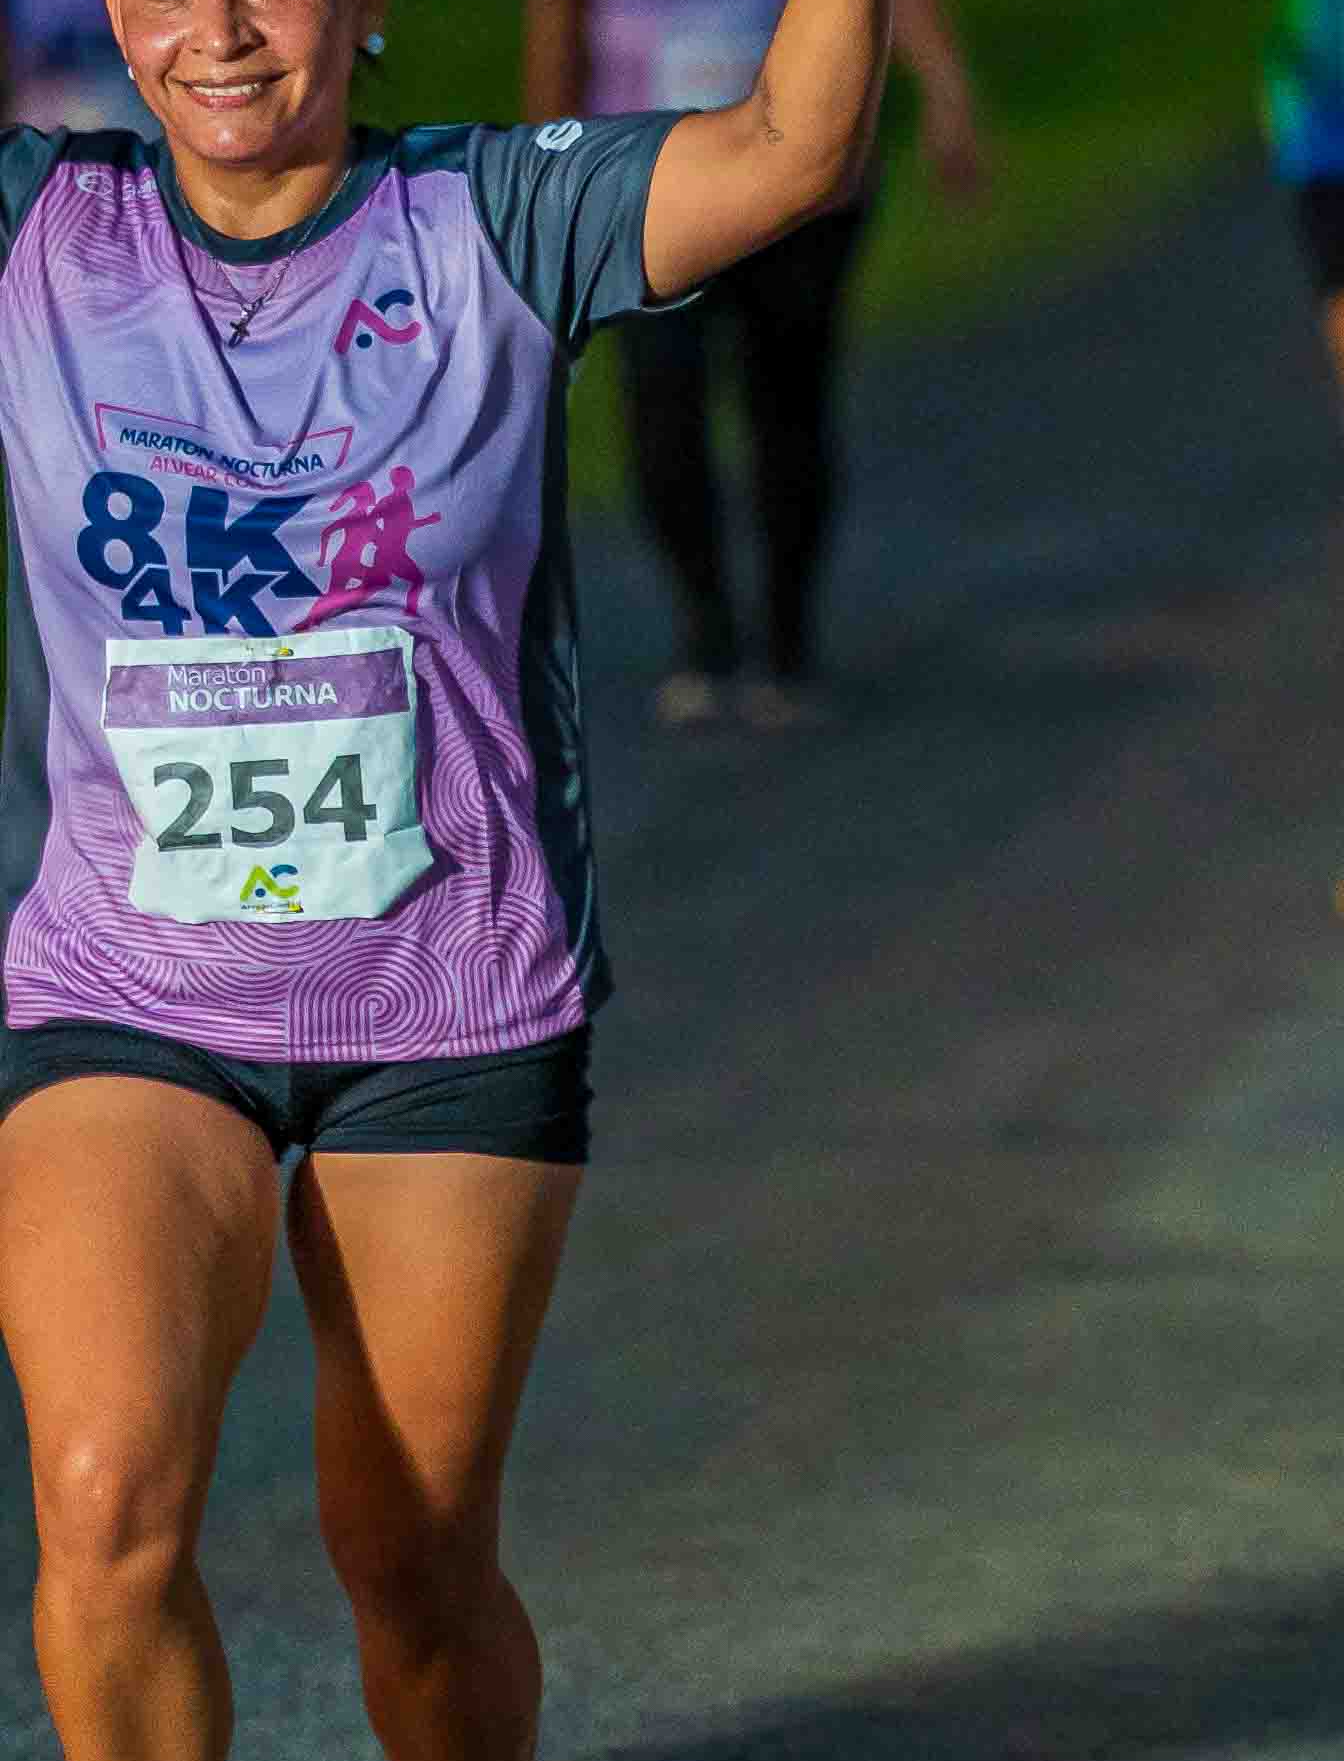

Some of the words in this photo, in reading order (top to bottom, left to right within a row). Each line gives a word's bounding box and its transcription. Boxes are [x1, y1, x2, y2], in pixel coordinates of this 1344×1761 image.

[119, 427, 214, 462] MARATON
[222, 452, 326, 480] NOCTURNA
[76, 471, 324, 598] 8K
[121, 568, 278, 637] 4K
[167, 663, 267, 687] Maratón
[168, 682, 339, 713] NOCTURNA
[152, 753, 378, 852] 254
